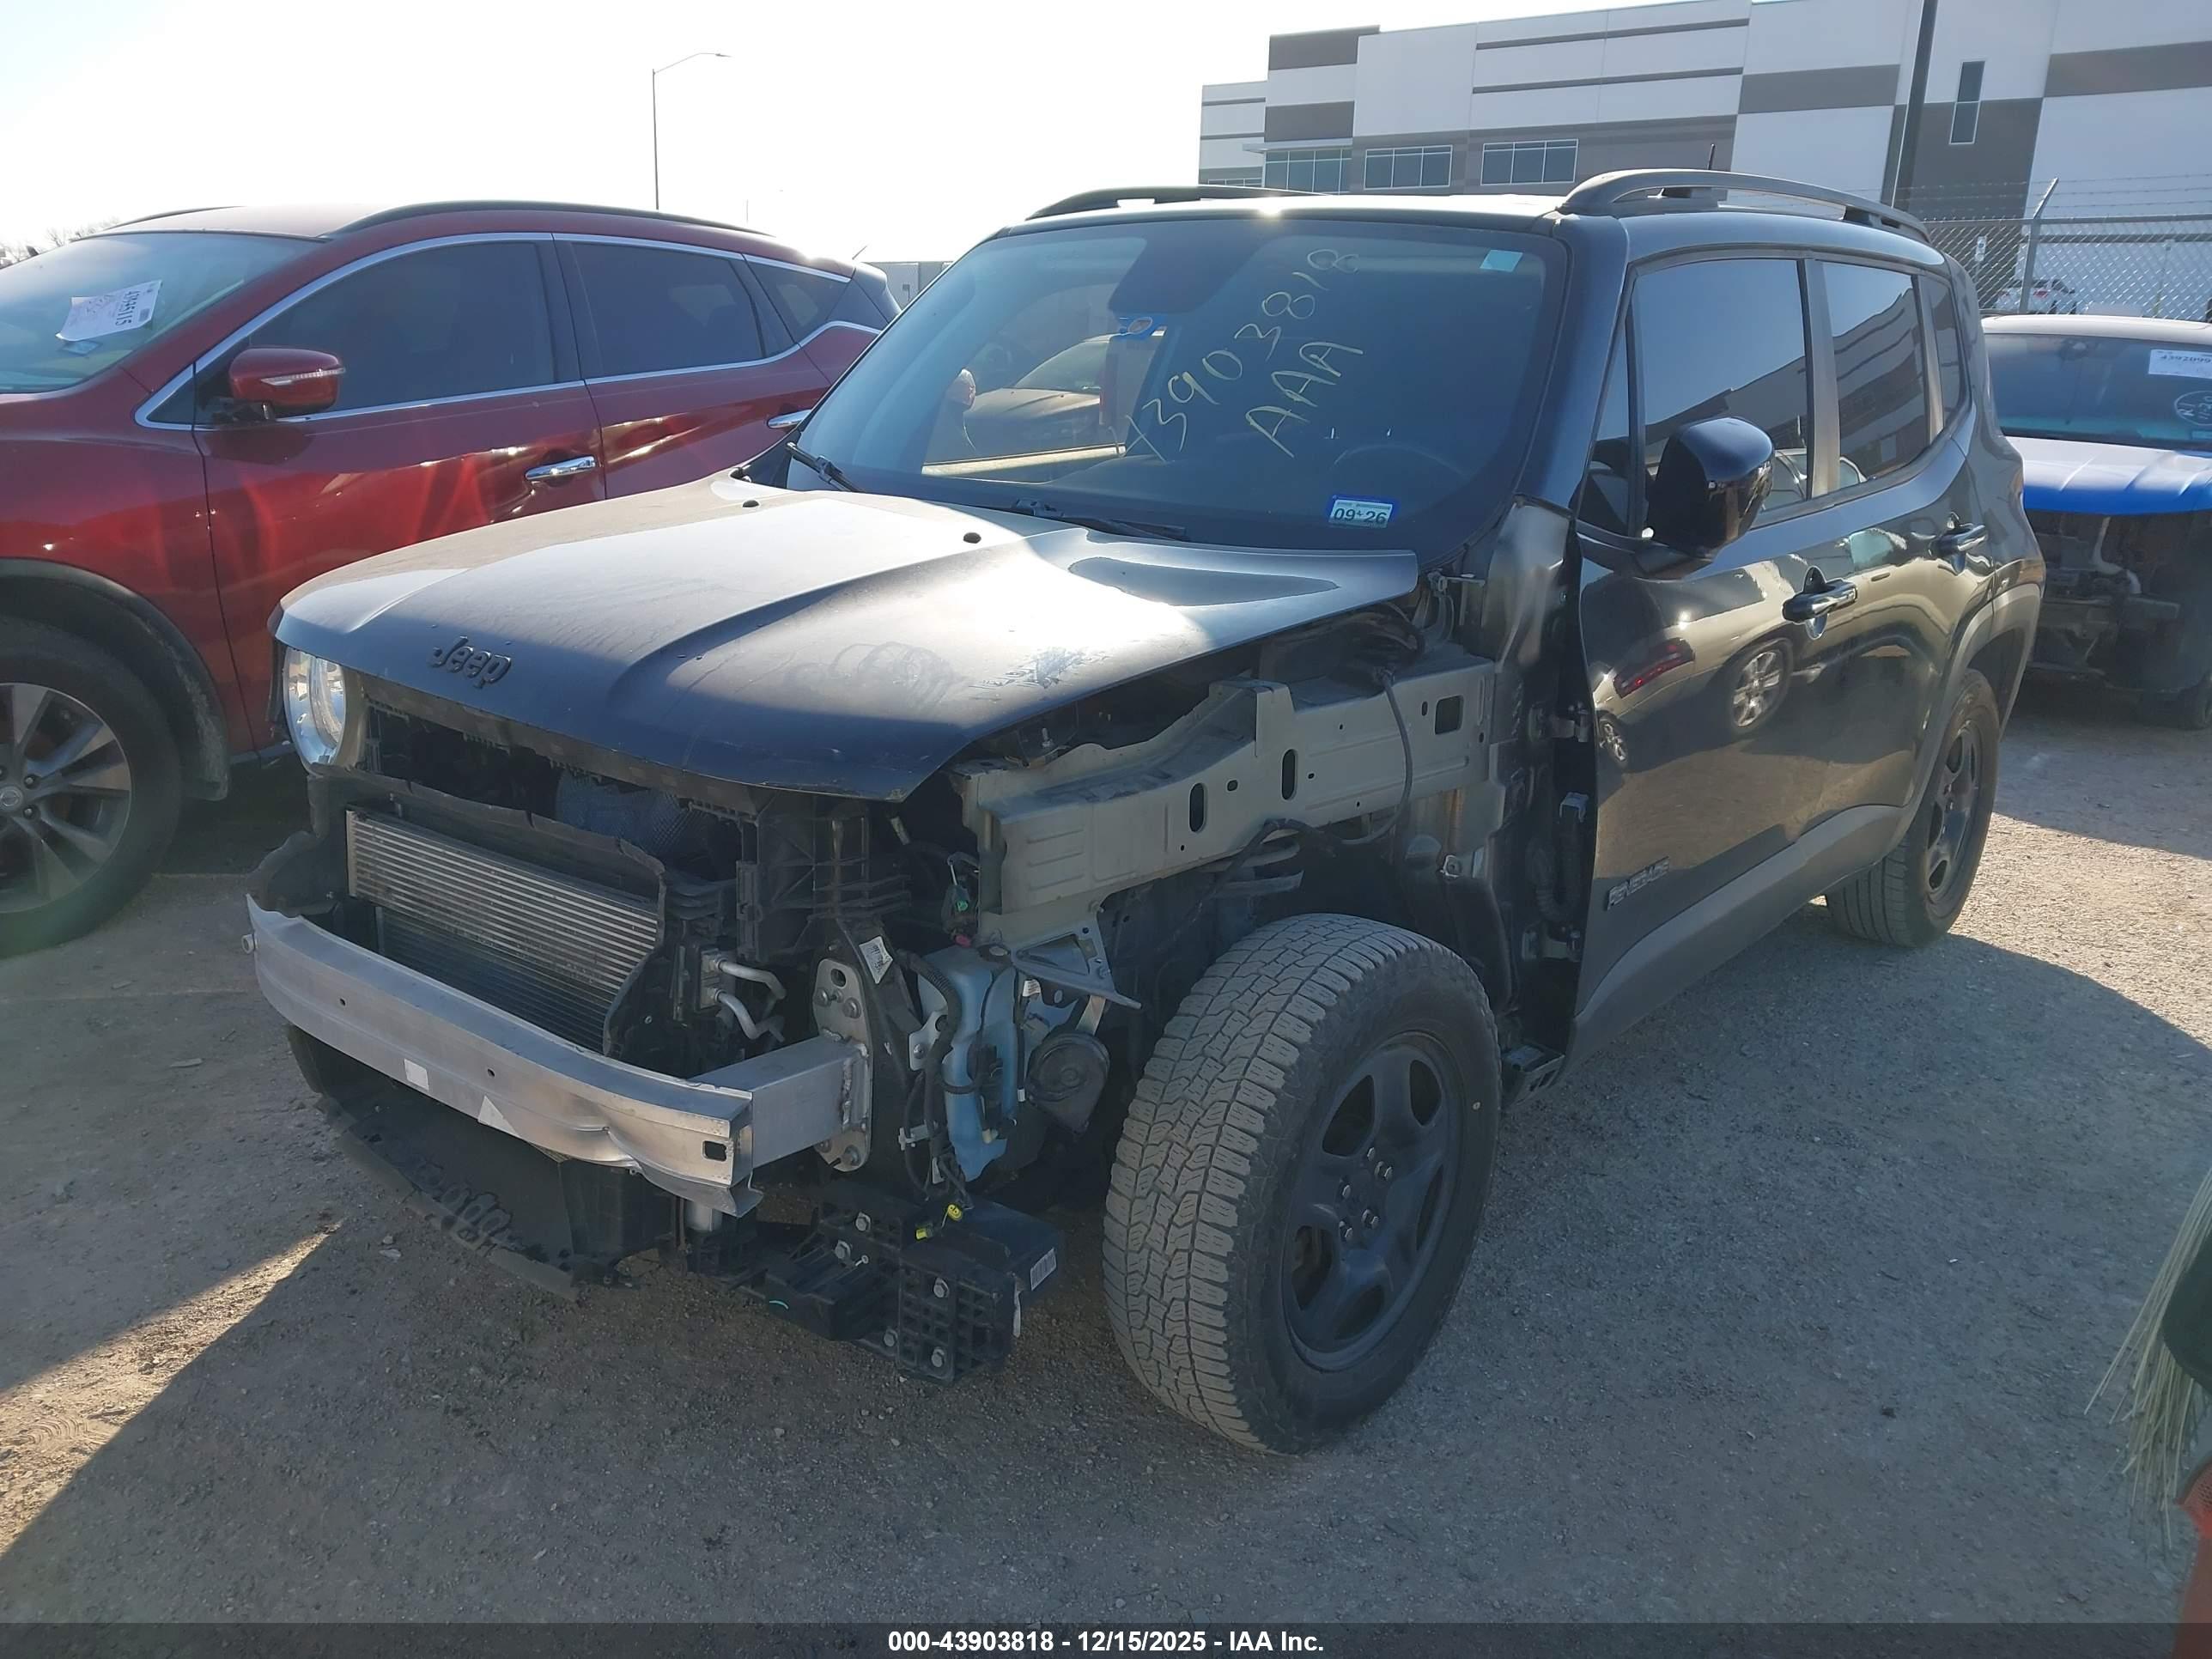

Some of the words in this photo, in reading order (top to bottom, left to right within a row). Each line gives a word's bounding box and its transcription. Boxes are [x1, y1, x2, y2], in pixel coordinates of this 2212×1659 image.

[1245, 341, 1364, 459] AAA
[1334, 507, 1356, 522] 09
[1364, 510, 1388, 525] 26
[428, 635, 513, 690] Jeep
